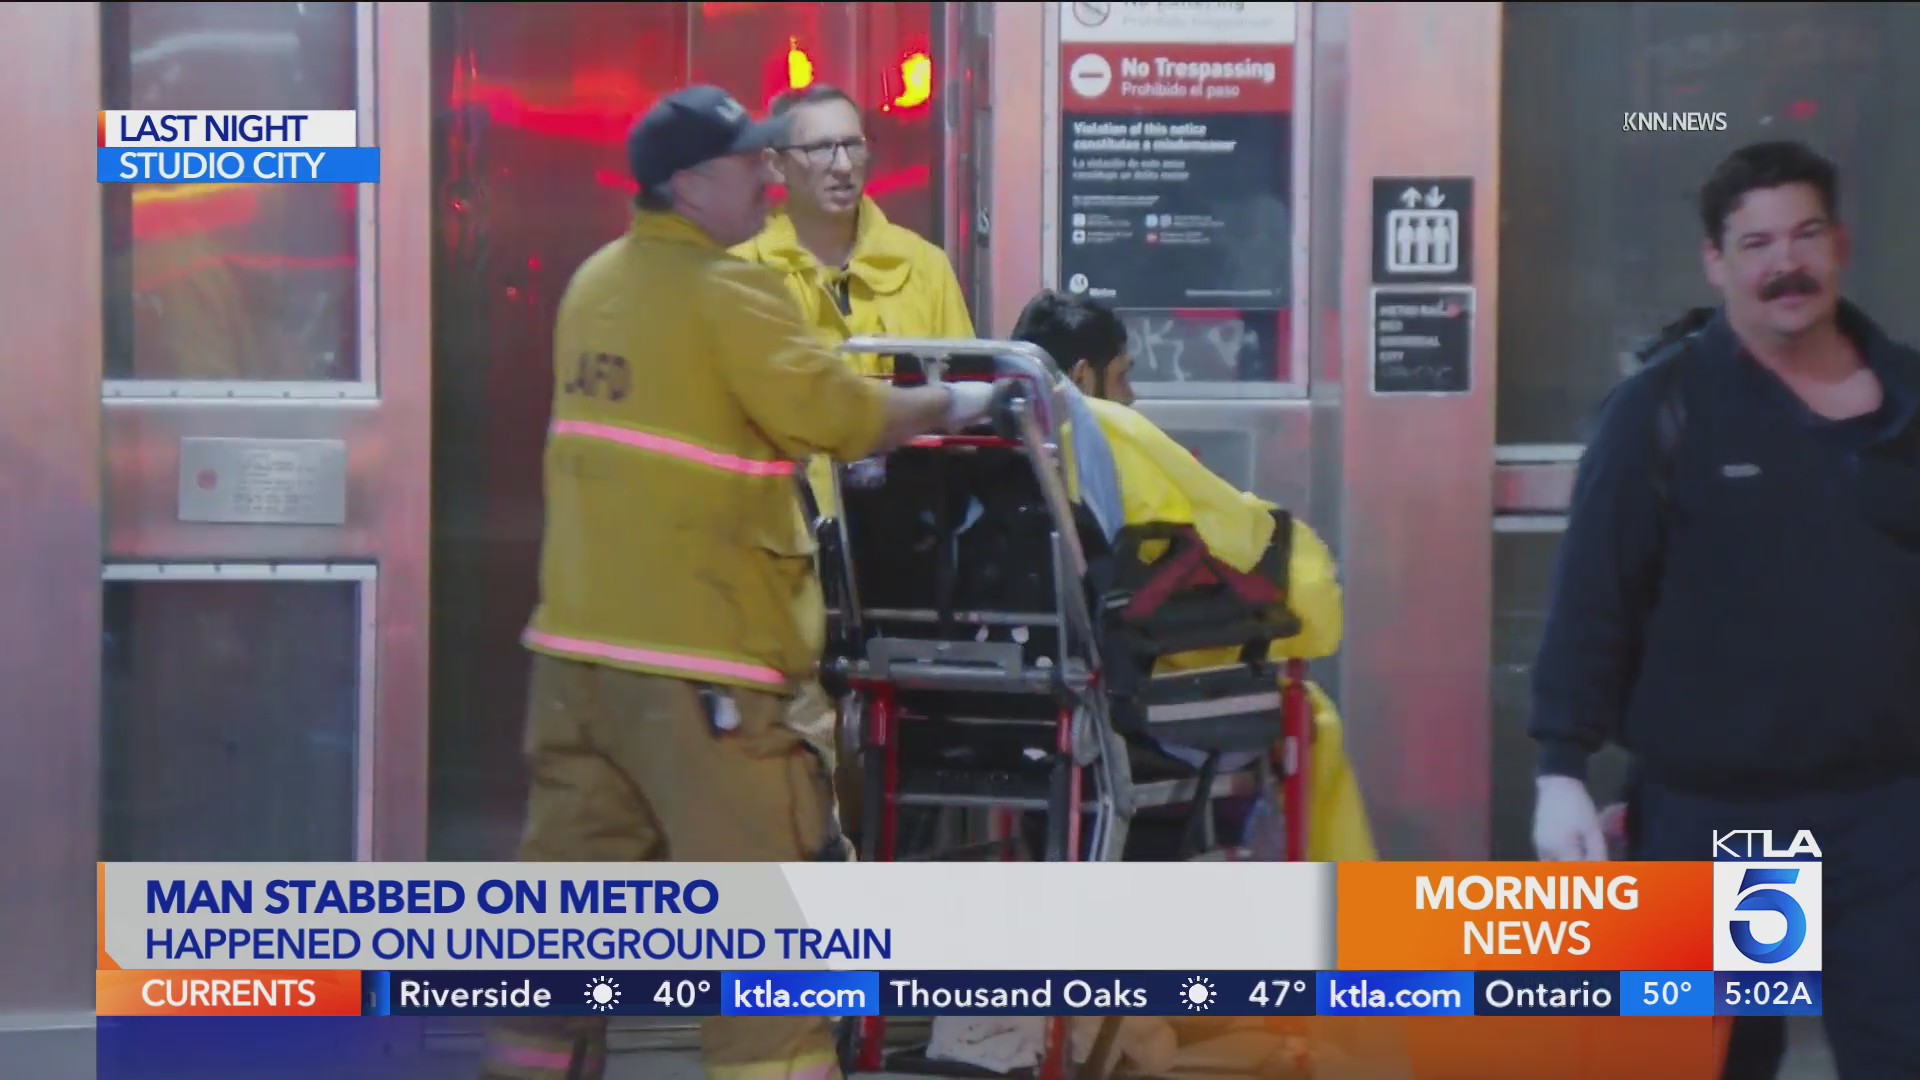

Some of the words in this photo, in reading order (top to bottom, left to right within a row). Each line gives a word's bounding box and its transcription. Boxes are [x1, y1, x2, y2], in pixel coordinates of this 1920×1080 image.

[1121, 58, 1150, 77] No
[1154, 57, 1275, 83] Trespassing
[1121, 81, 1187, 97] Prohibido
[1189, 81, 1203, 97] el
[1206, 84, 1240, 99] paso
[1073, 121, 1127, 135] Violation
[1129, 121, 1142, 135] of
[1143, 121, 1168, 135] this
